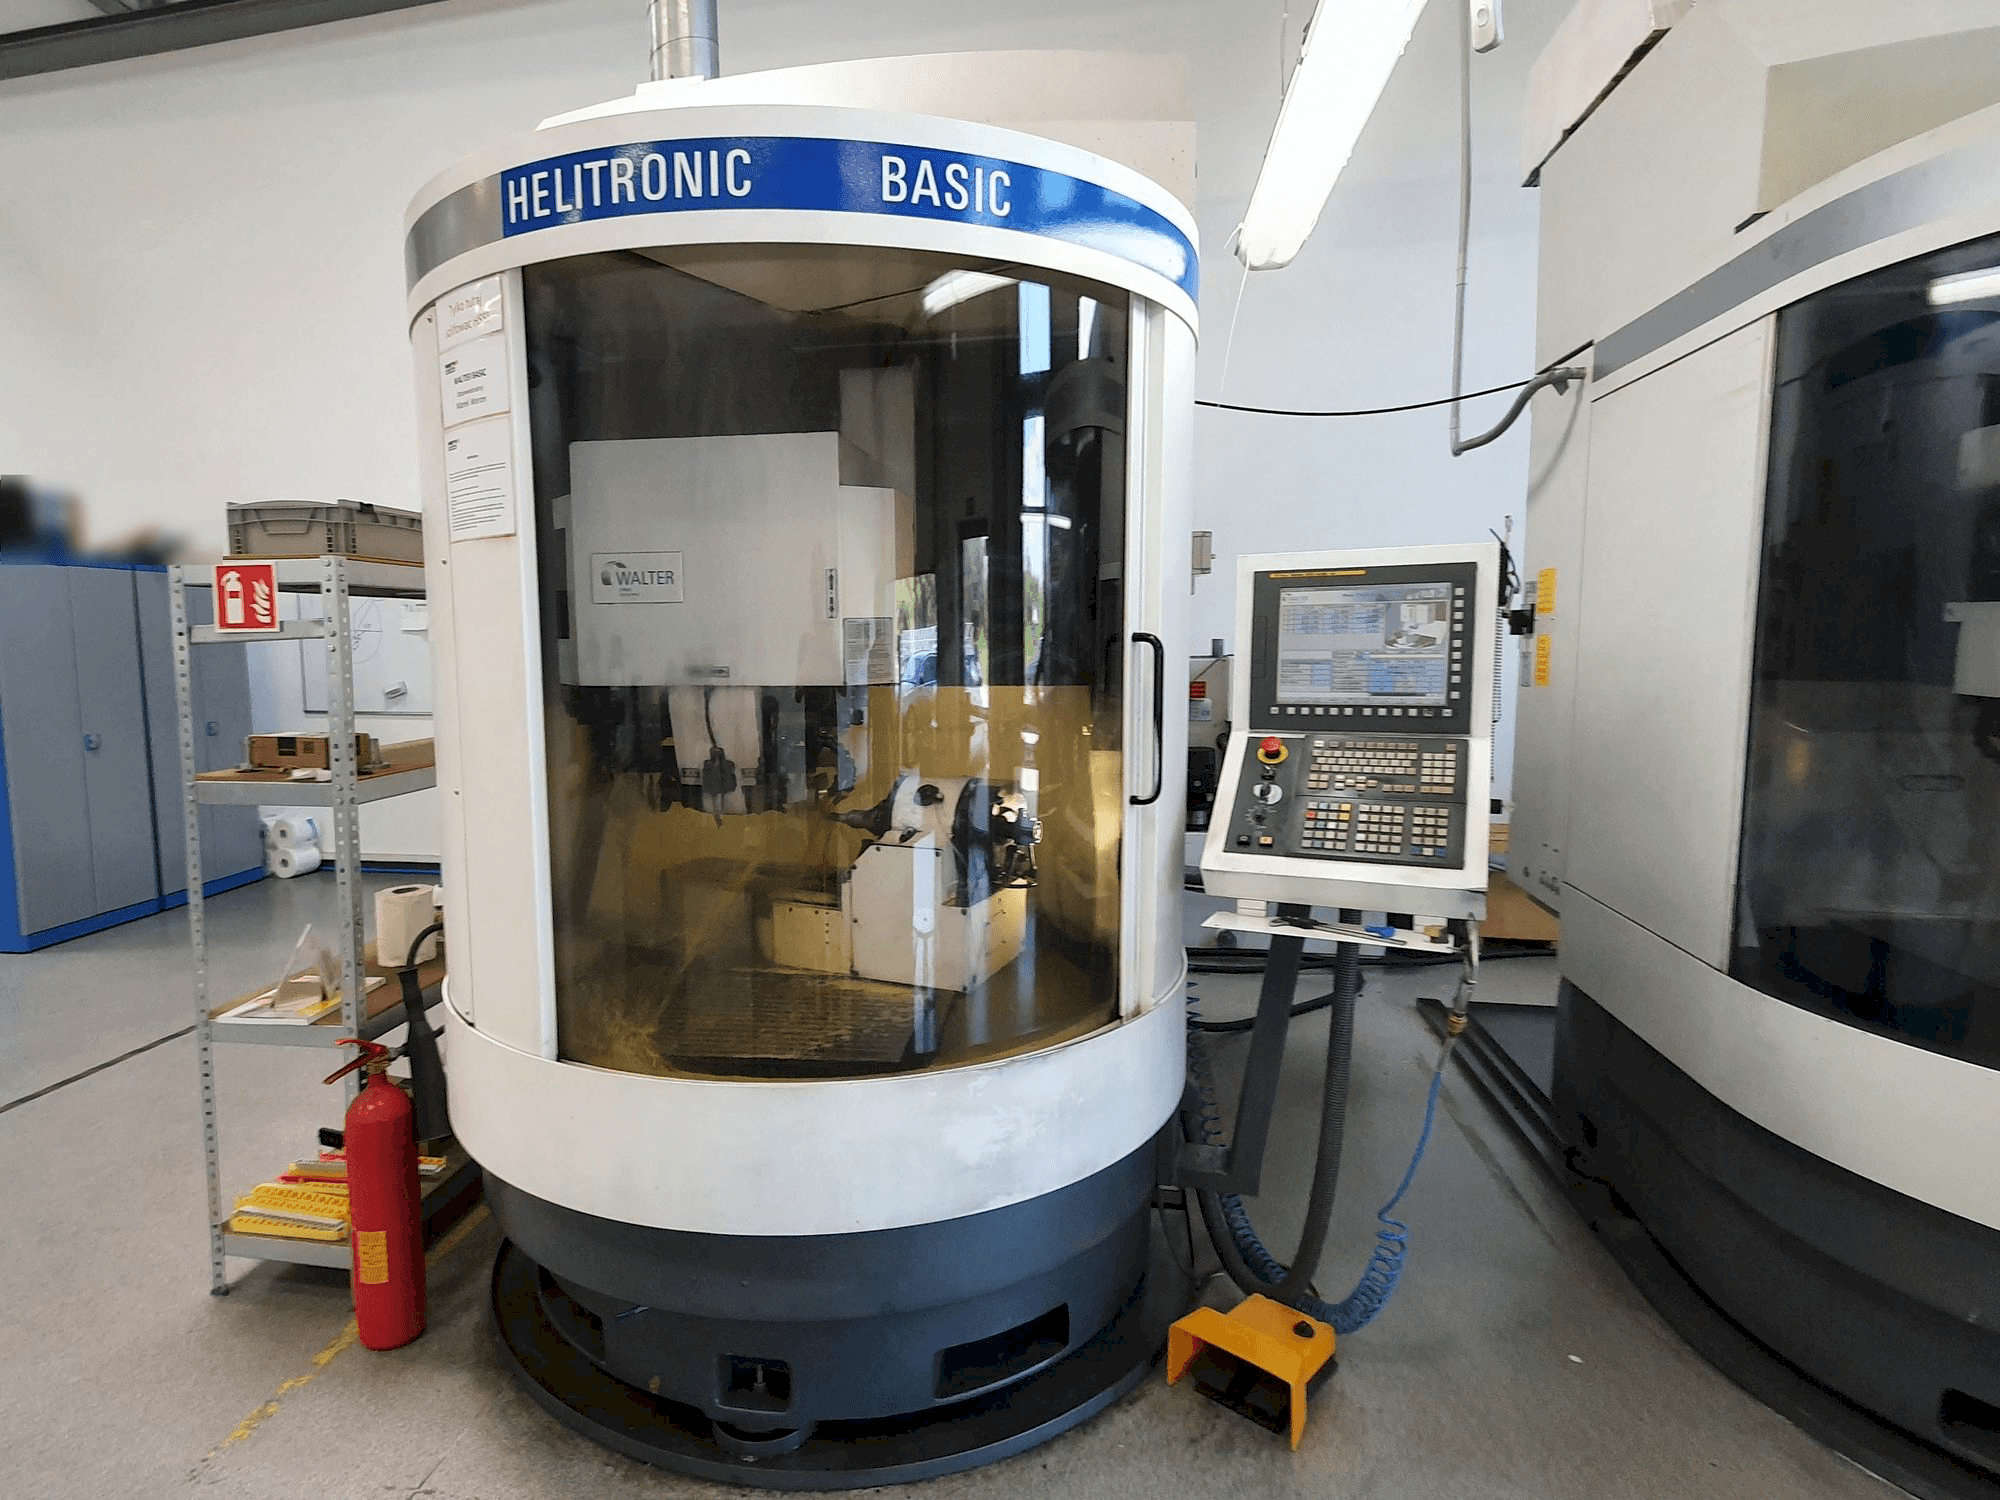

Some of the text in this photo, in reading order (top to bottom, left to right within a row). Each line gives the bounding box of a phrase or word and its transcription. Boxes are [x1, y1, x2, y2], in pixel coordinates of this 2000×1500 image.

[507, 148, 1011, 224] HELITRONIC BASIC
[615, 570, 675, 586] WALTER
